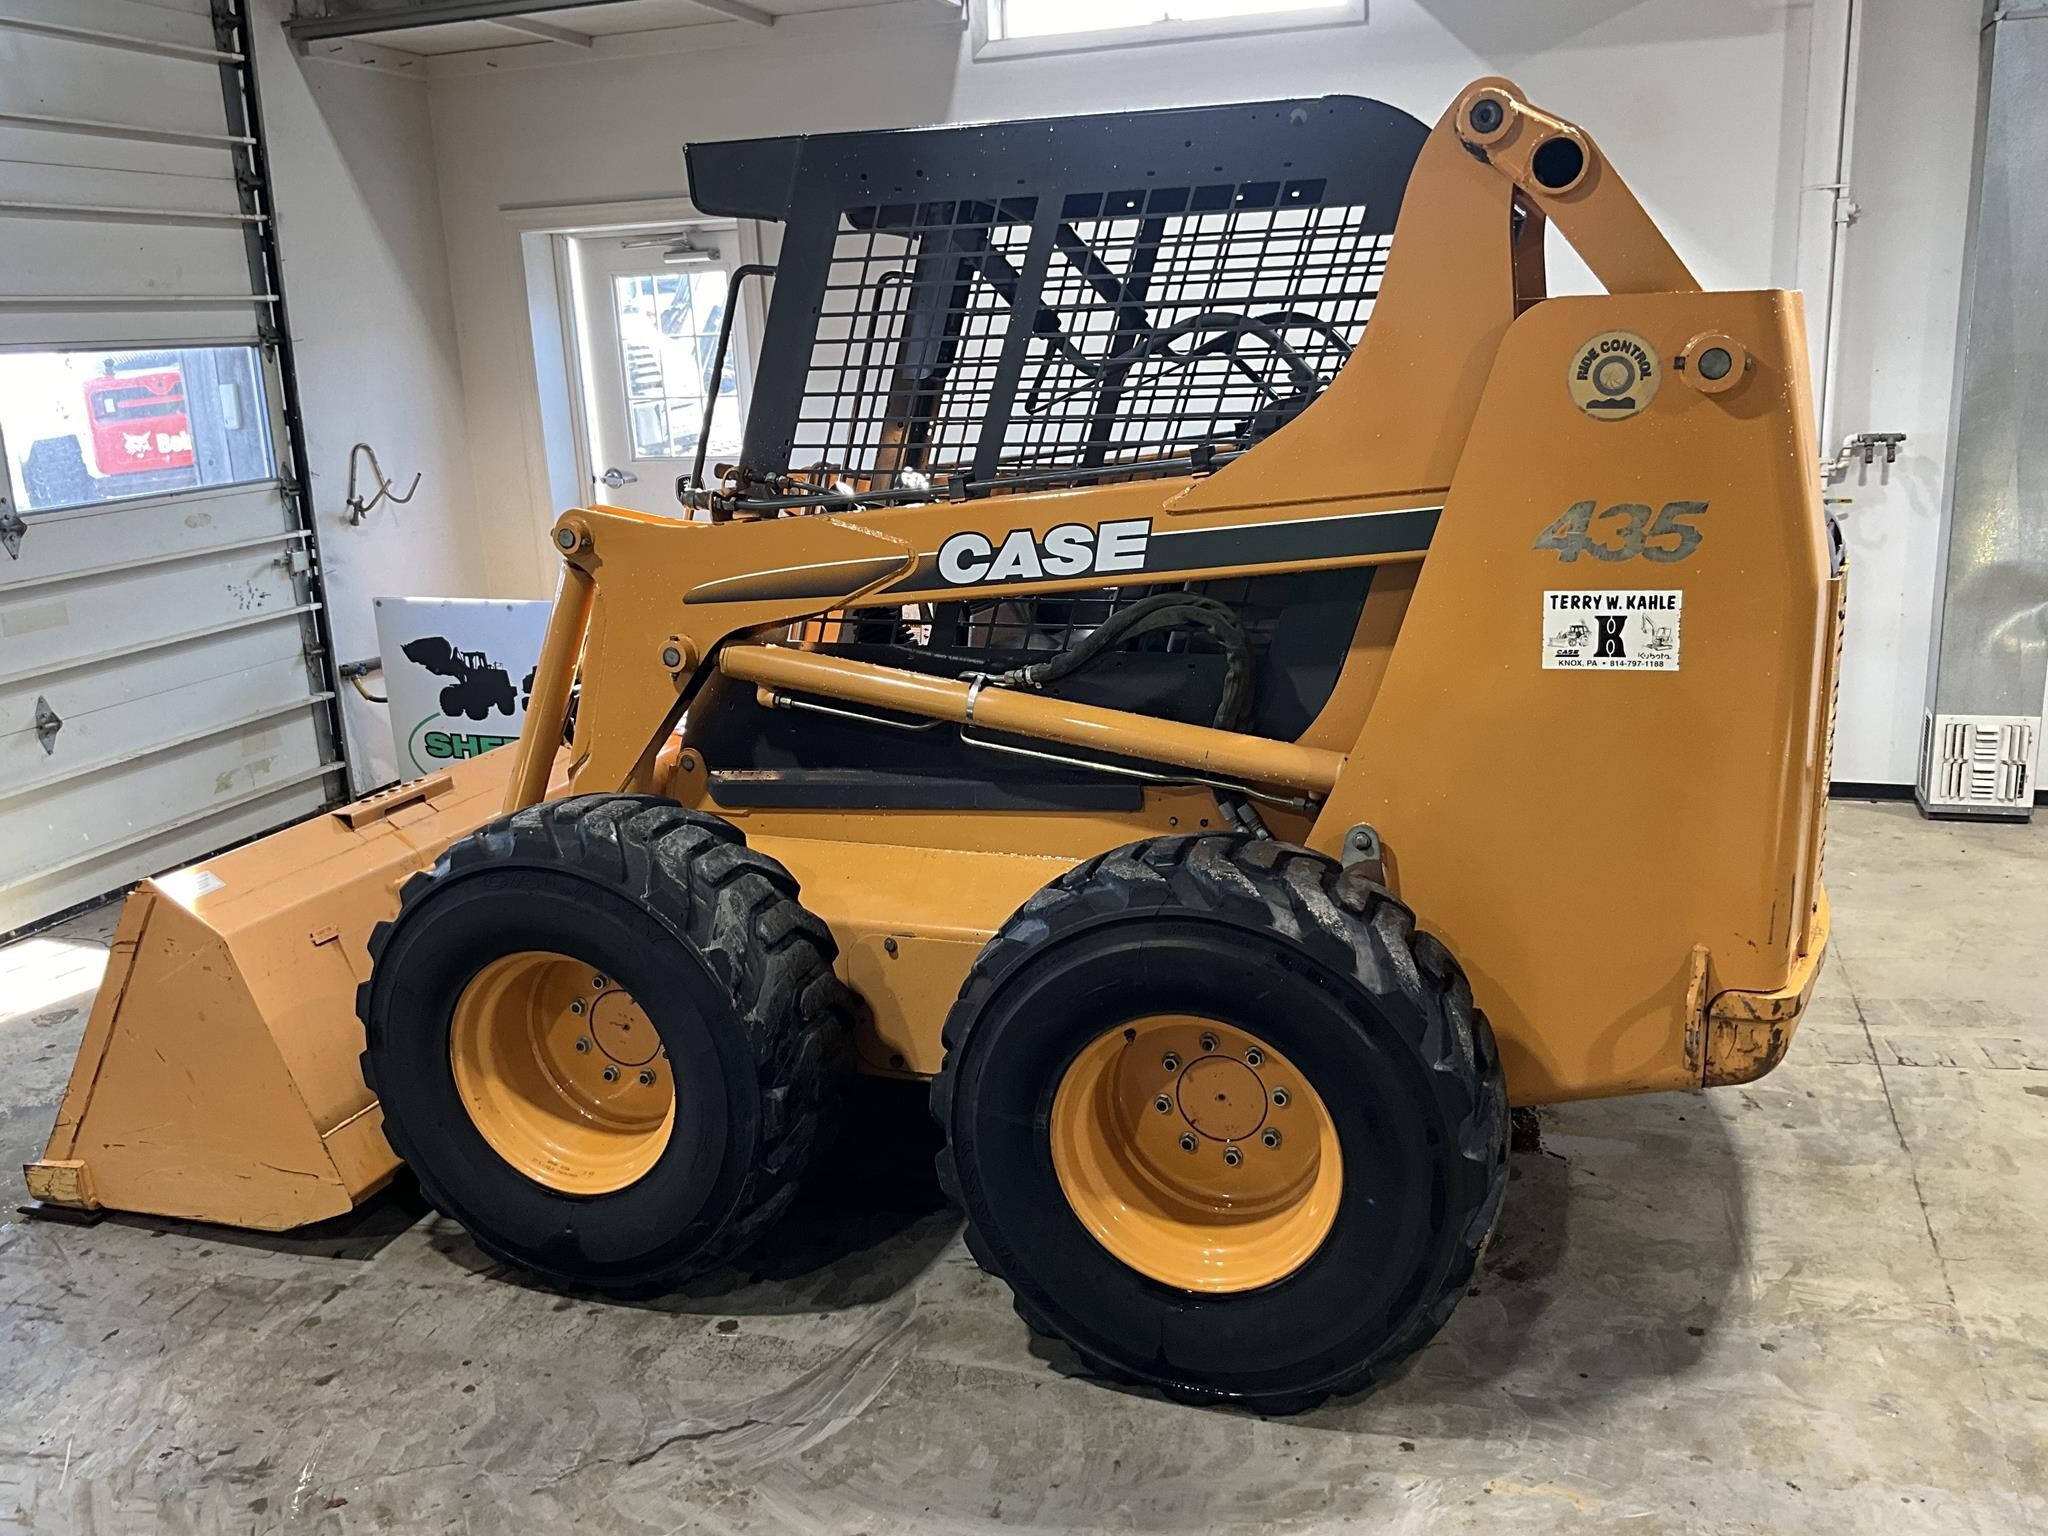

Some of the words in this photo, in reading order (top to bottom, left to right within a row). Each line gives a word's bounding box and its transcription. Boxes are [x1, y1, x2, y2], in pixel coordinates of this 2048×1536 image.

[1576, 347, 1600, 381] RIDE
[1600, 338, 1652, 382] CONTROL
[1533, 500, 1709, 564] 435
[936, 517, 1153, 586] CASE
[1550, 594, 1602, 611] TERRY
[1607, 595, 1622, 610] W.
[1626, 594, 1676, 610] KAHLE
[1609, 660, 1664, 668] 814-797-1188
[424, 731, 521, 760] SHE
